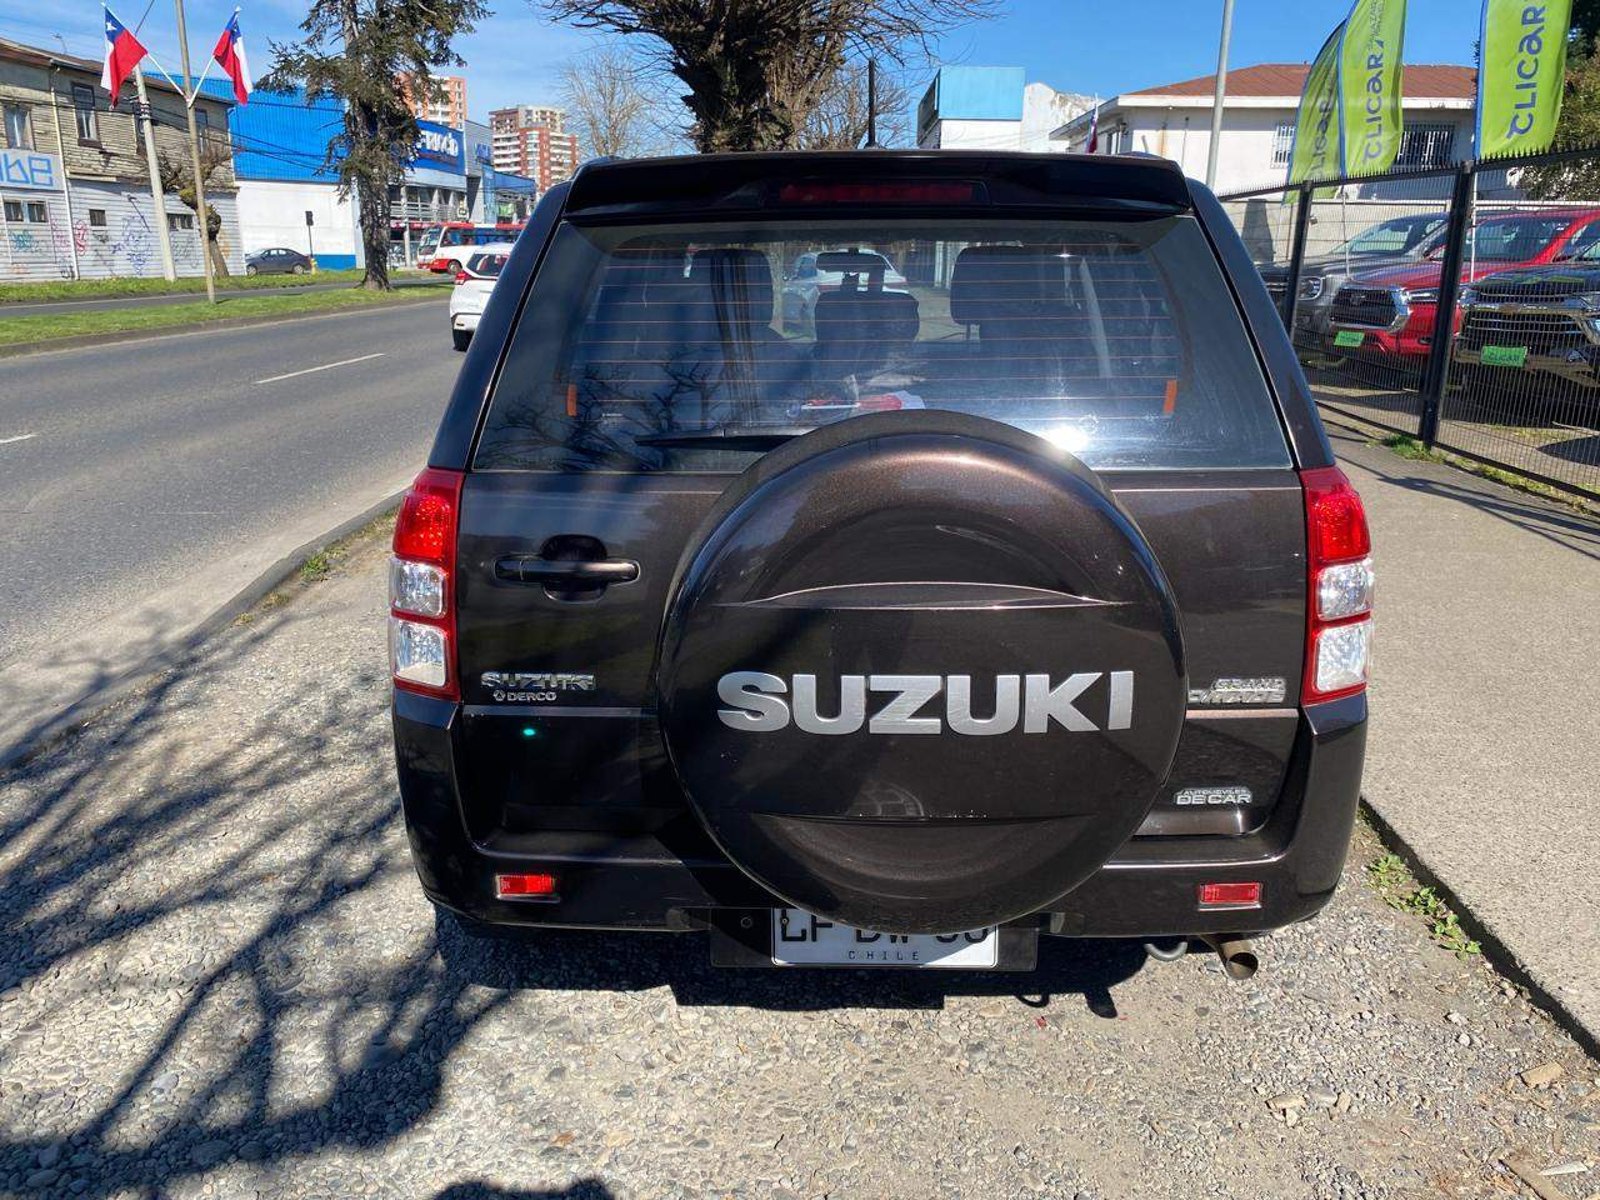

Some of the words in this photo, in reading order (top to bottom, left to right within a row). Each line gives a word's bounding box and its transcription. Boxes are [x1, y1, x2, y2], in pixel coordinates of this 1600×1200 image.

[481, 671, 595, 690] SUZUKI
[507, 691, 557, 702] DERCO
[717, 670, 1134, 736] SUZUKI
[848, 950, 919, 961] CHILE
